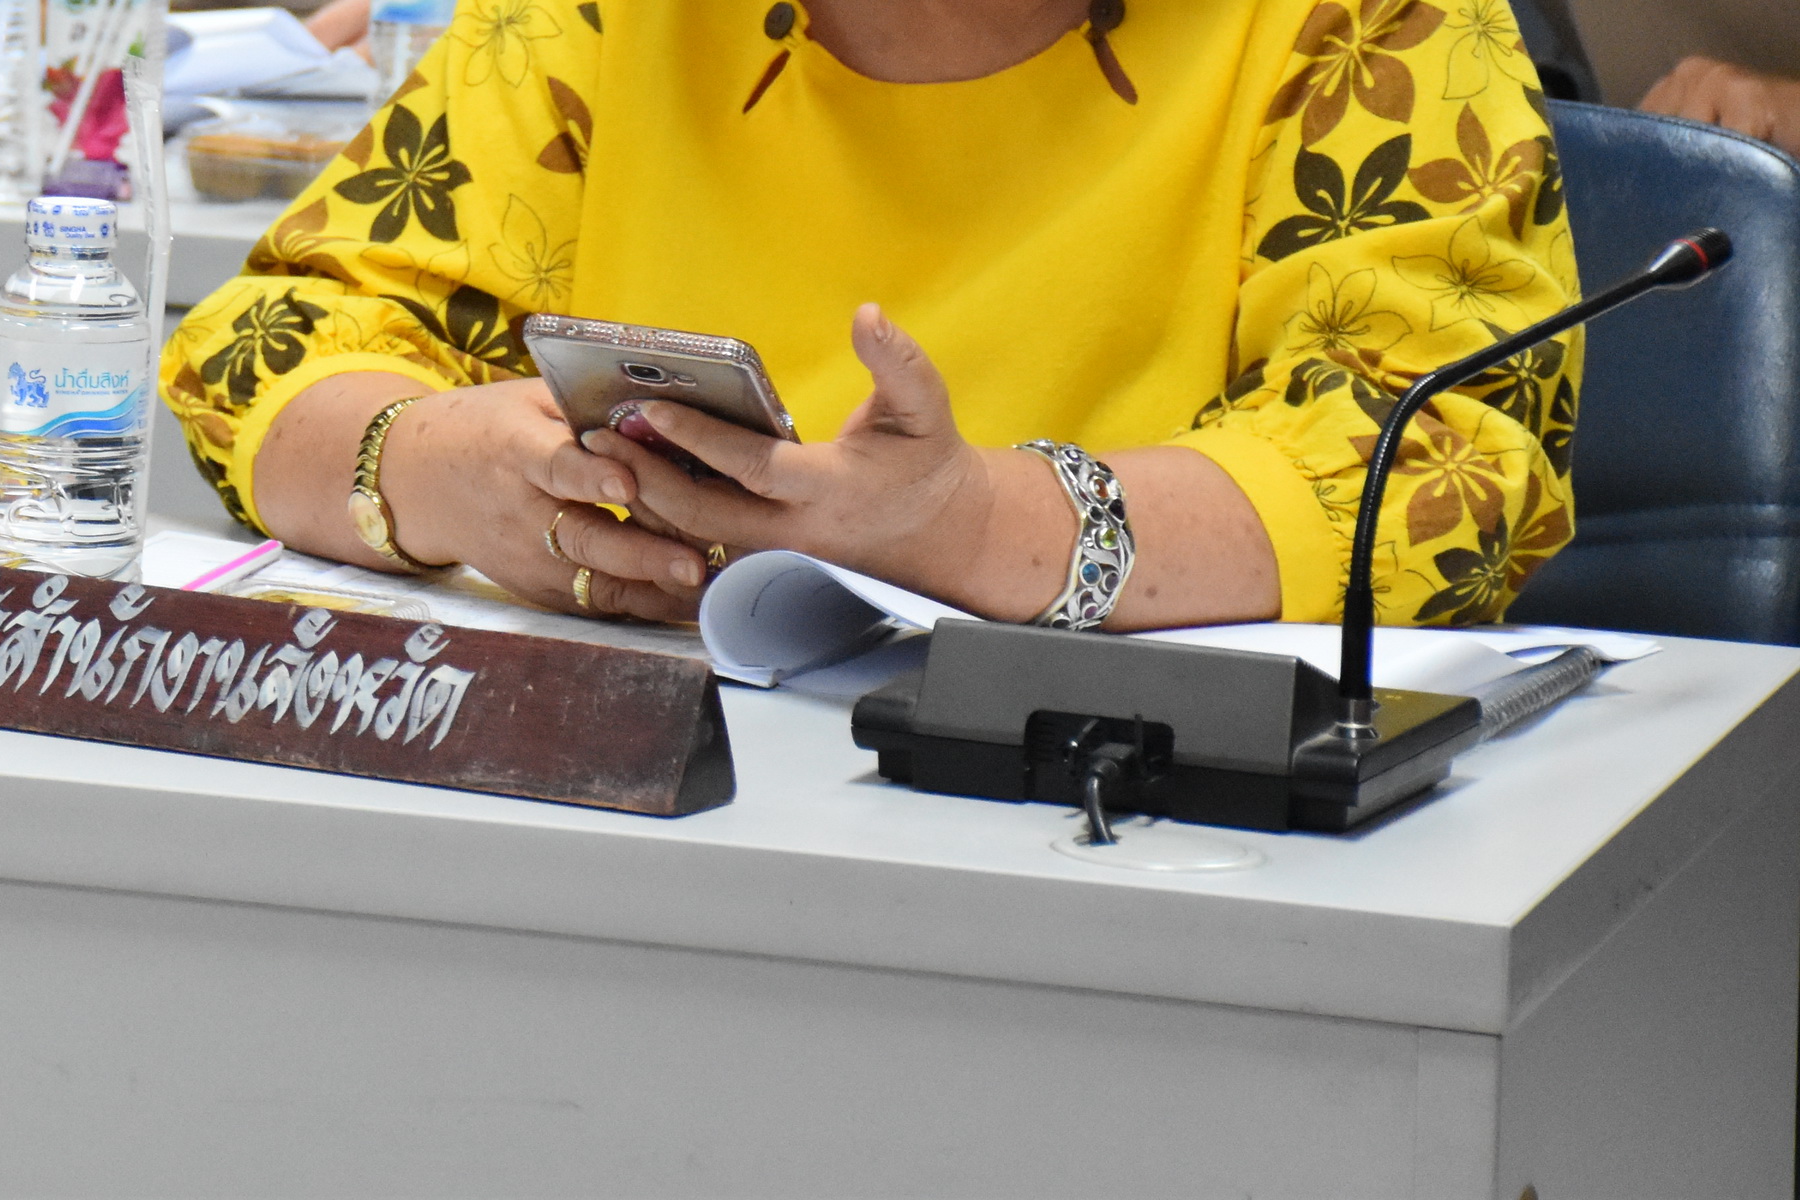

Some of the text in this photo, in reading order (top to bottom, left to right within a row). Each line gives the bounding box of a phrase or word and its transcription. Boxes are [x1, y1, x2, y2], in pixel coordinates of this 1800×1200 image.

[55, 367, 130, 389] น้ำดื่มสิงห์
